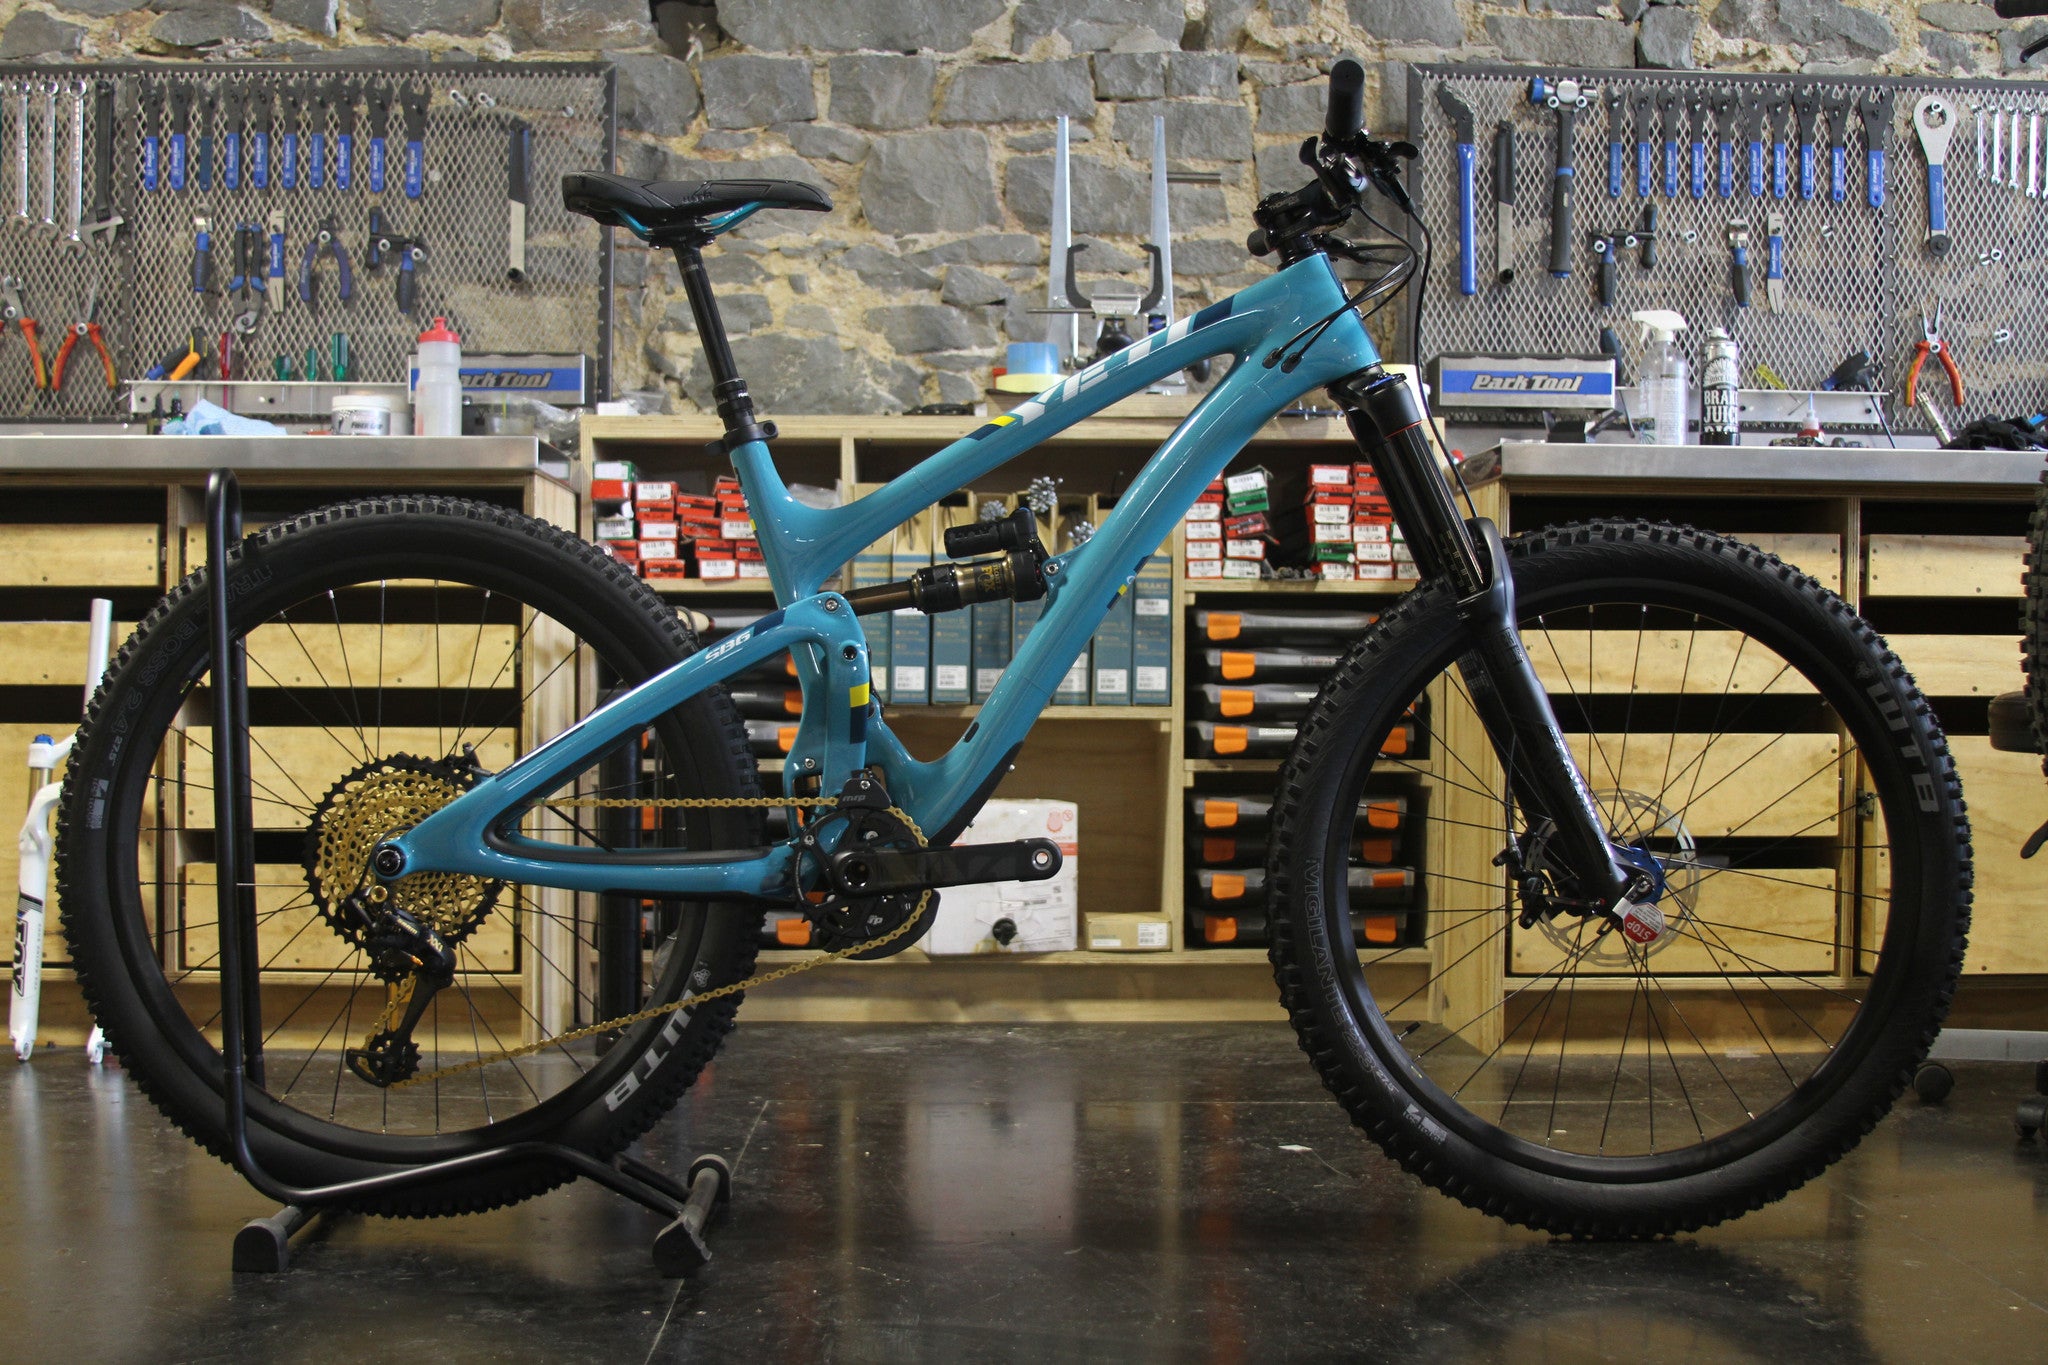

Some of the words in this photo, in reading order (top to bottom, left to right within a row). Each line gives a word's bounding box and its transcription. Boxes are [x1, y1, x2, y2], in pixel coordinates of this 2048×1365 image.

[459, 371, 497, 388] ark
[496, 372, 552, 388] Tool
[1010, 315, 1192, 426] YETI
[1471, 374, 1529, 391] Park
[1529, 375, 1583, 392] Tool
[1703, 390, 1738, 405] BRAK
[1703, 405, 1738, 423] JUIC
[195, 564, 273, 617] TRAL
[137, 618, 199, 687] BOSS
[705, 630, 751, 663] SB6
[110, 686, 142, 734] 2.4
[1866, 681, 1940, 812] WTB
[1626, 920, 1652, 940] STOP
[1304, 861, 1350, 1026] VIGILANTE
[1342, 1031, 1377, 1075] 2.3
[605, 988, 698, 1112] WTB
